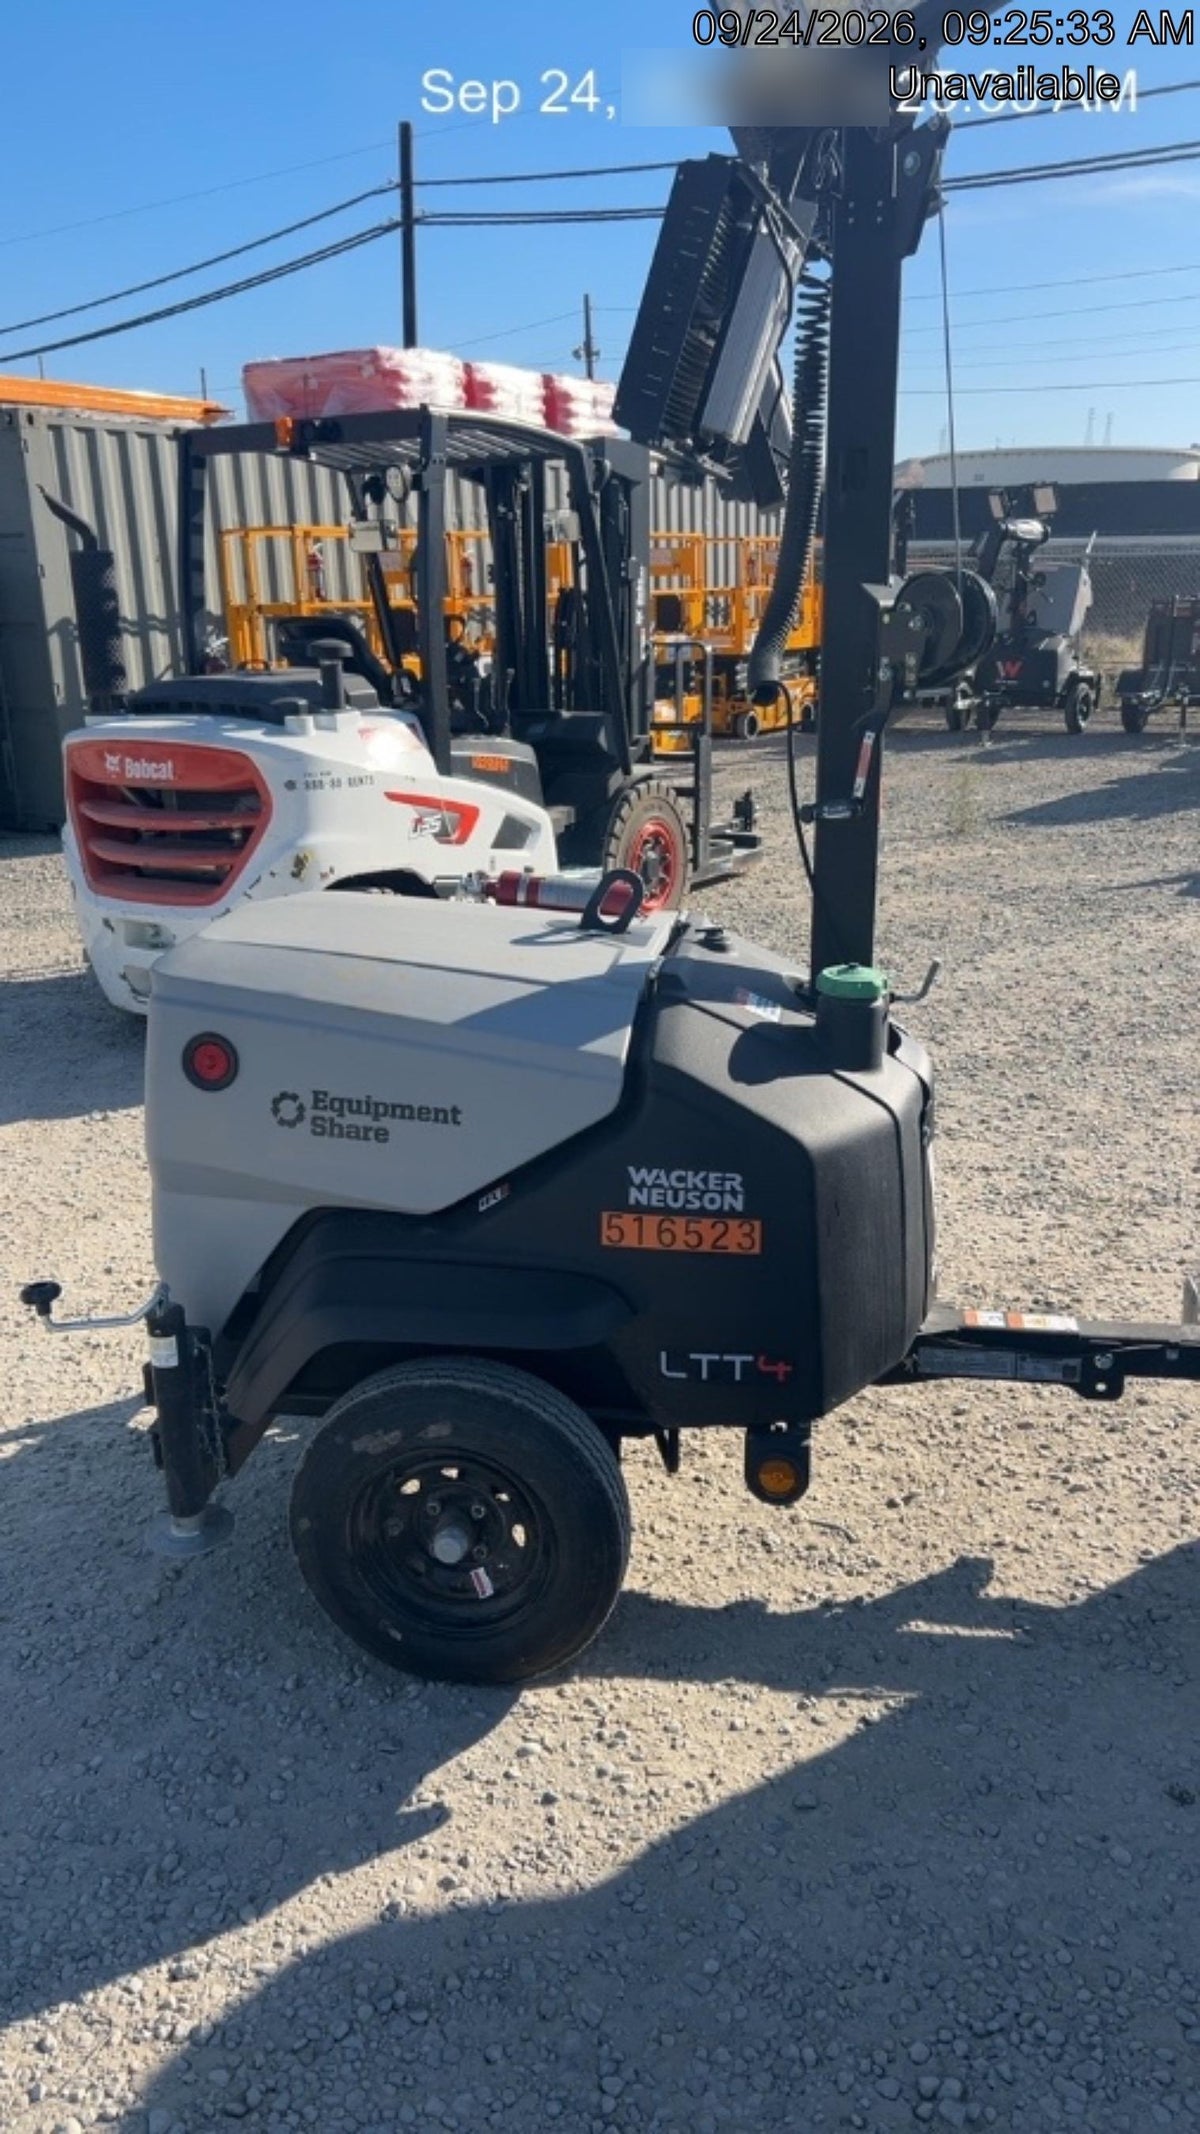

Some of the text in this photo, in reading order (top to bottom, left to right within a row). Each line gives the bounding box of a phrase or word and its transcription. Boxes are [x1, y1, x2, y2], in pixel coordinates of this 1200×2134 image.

[125, 757, 174, 780] Bobcat
[311, 1090, 462, 1126] Equipment
[310, 1116, 390, 1144] Share
[627, 1166, 743, 1191] WACKER
[628, 1187, 743, 1212] NEUSON
[605, 1213, 757, 1251] 516523
[660, 1350, 793, 1382] LTT4
